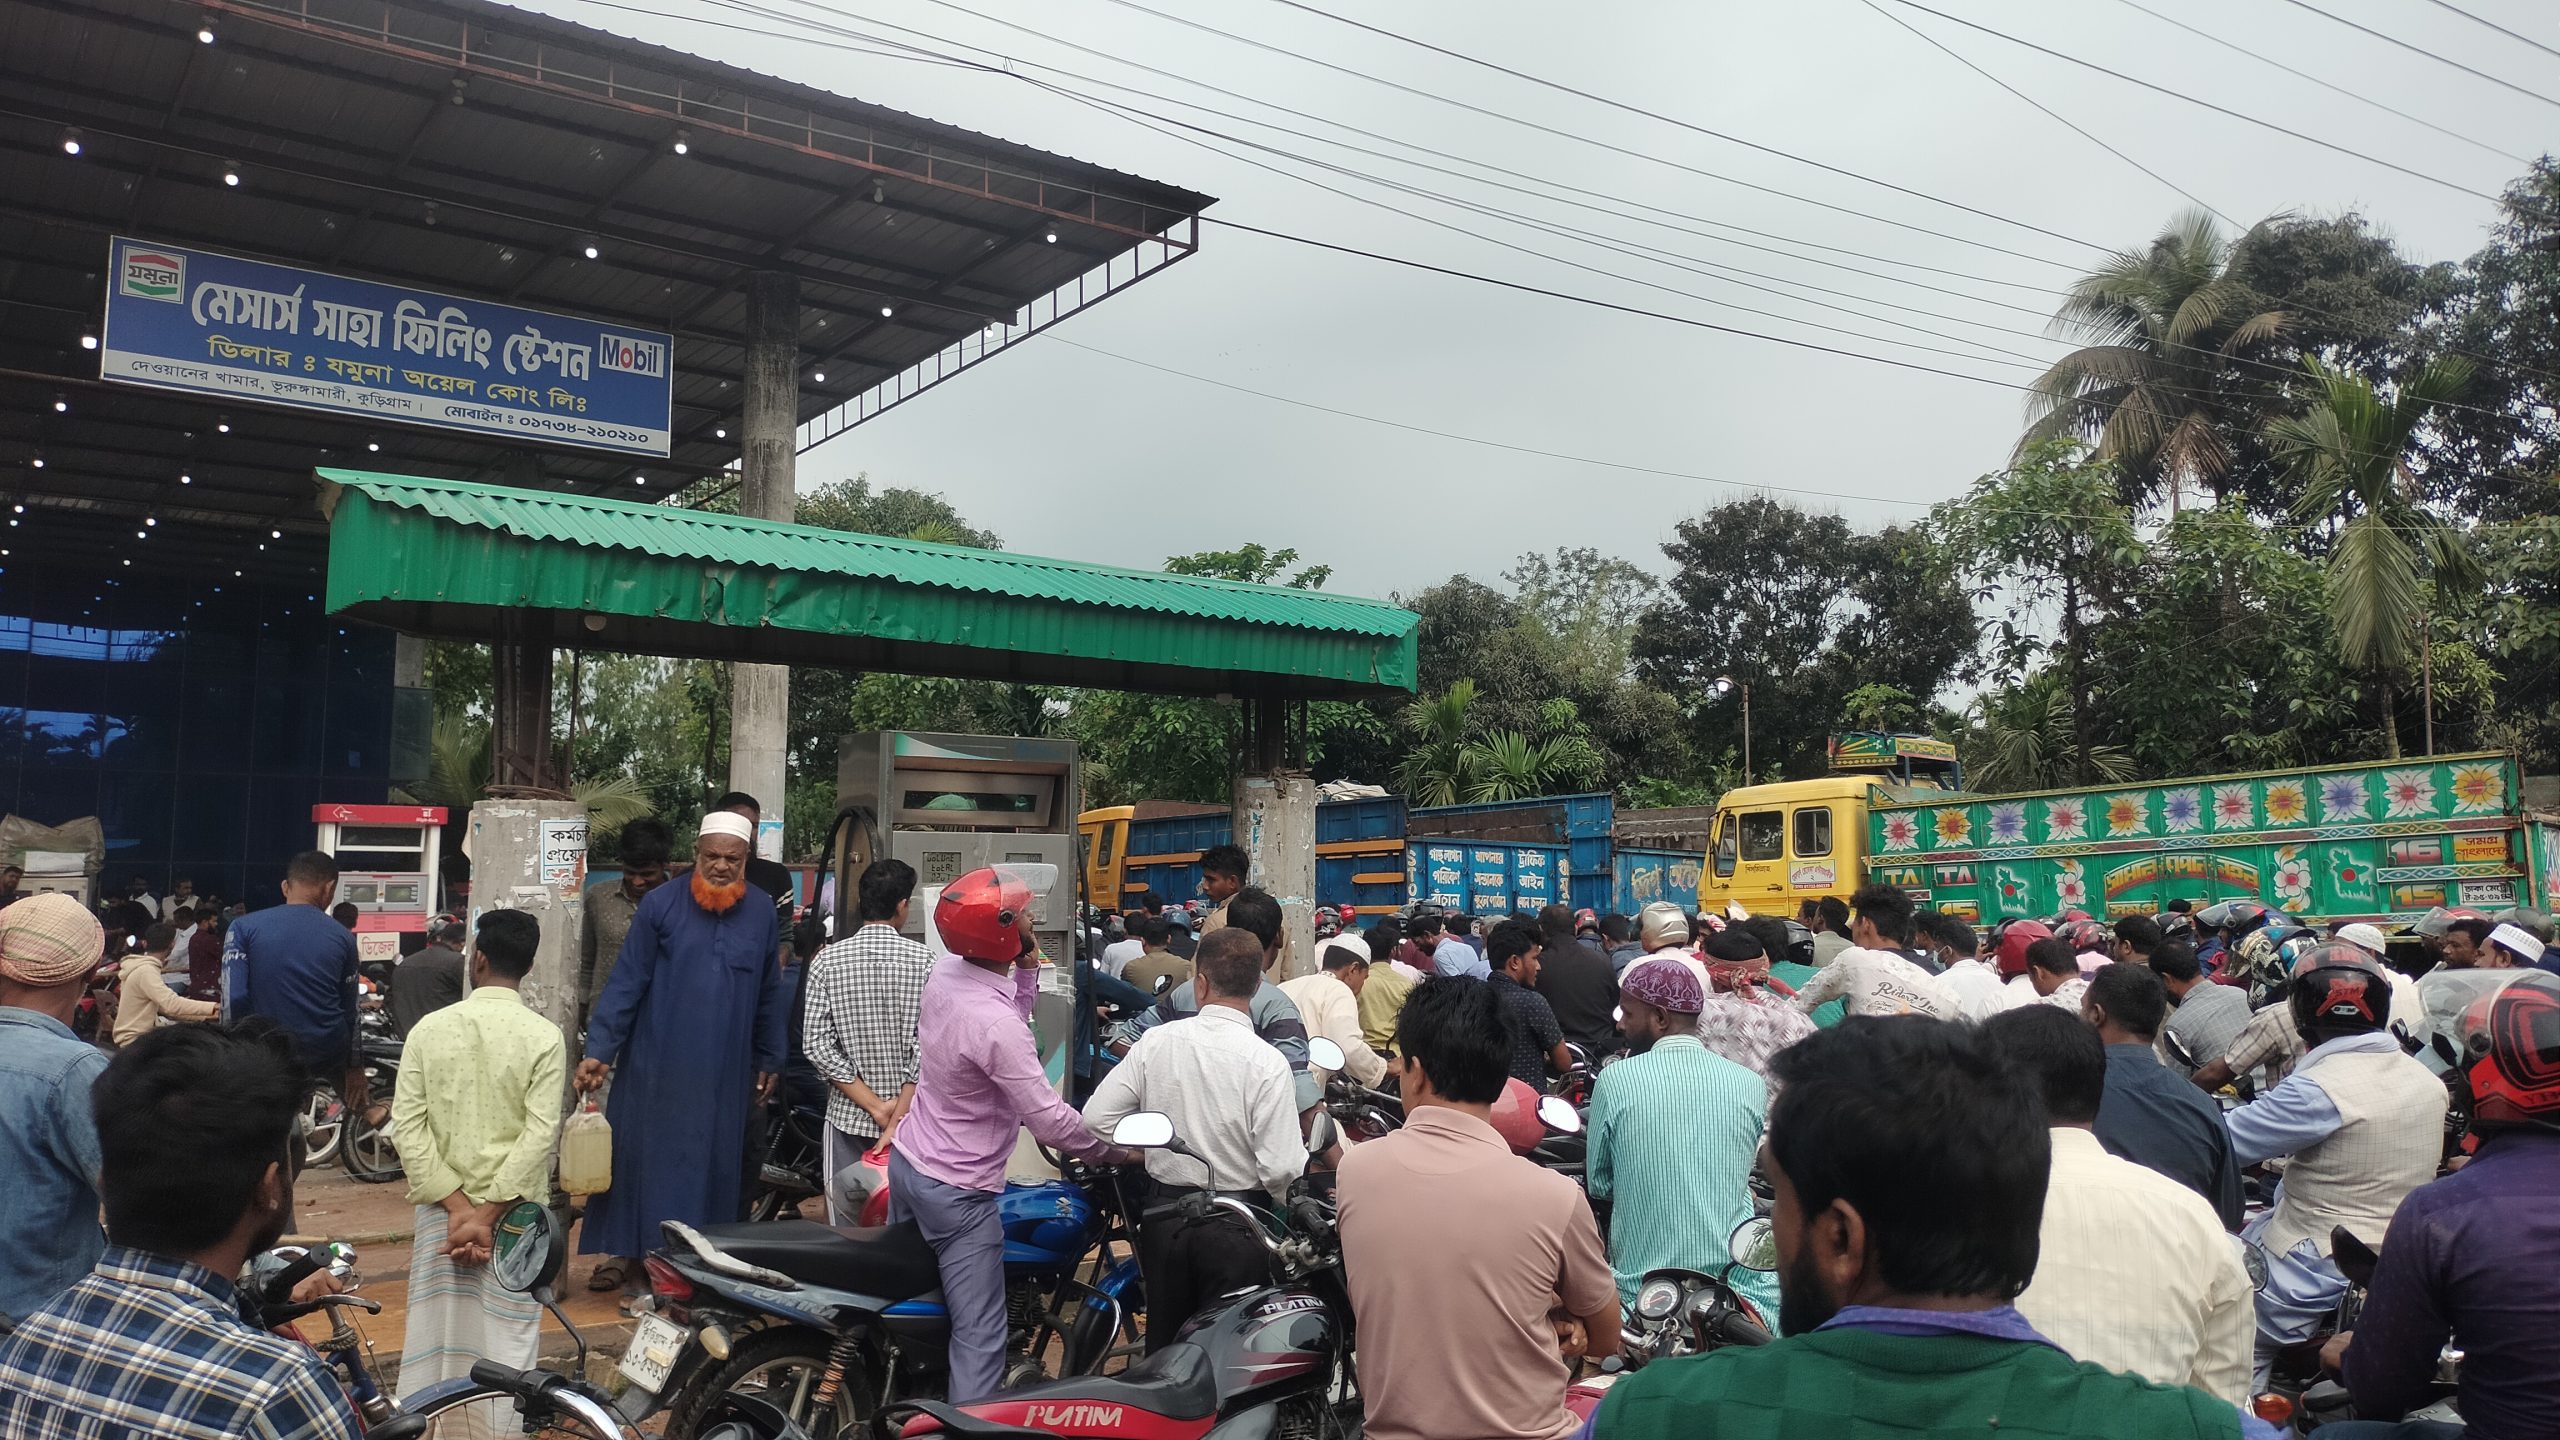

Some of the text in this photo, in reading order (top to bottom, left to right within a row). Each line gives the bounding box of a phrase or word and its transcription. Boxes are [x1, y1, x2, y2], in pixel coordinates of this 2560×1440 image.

[128, 264, 179, 286] যমুনা
[191, 281, 306, 335] মেসার্স
[312, 299, 384, 349] সাহা
[393, 299, 492, 370] ফিলিং
[602, 336, 659, 374] Mobil
[131, 359, 208, 382] দেওয়ানের
[216, 371, 265, 391] খামার,
[206, 335, 292, 368] ডিলার
[325, 357, 394, 385] যমুনা
[401, 368, 477, 396] অয়েল
[486, 382, 541, 408] কোং
[444, 405, 503, 423] মোবাইল
[519, 416, 649, 443] ০১৭৩৮-২১০২১০
[2391, 839, 2441, 863] 16
[2463, 836, 2498, 847] সমগ্র
[1519, 871, 1545, 890] আইন
[1885, 866, 1973, 885] TA TA
[2395, 883, 2445, 907] 15
[1940, 902, 1978, 922] 15
[361, 936, 395, 957] ডিজেল
[1263, 1295, 1327, 1315] PLATINA
[1024, 1405, 1123, 1427] PLATINA
